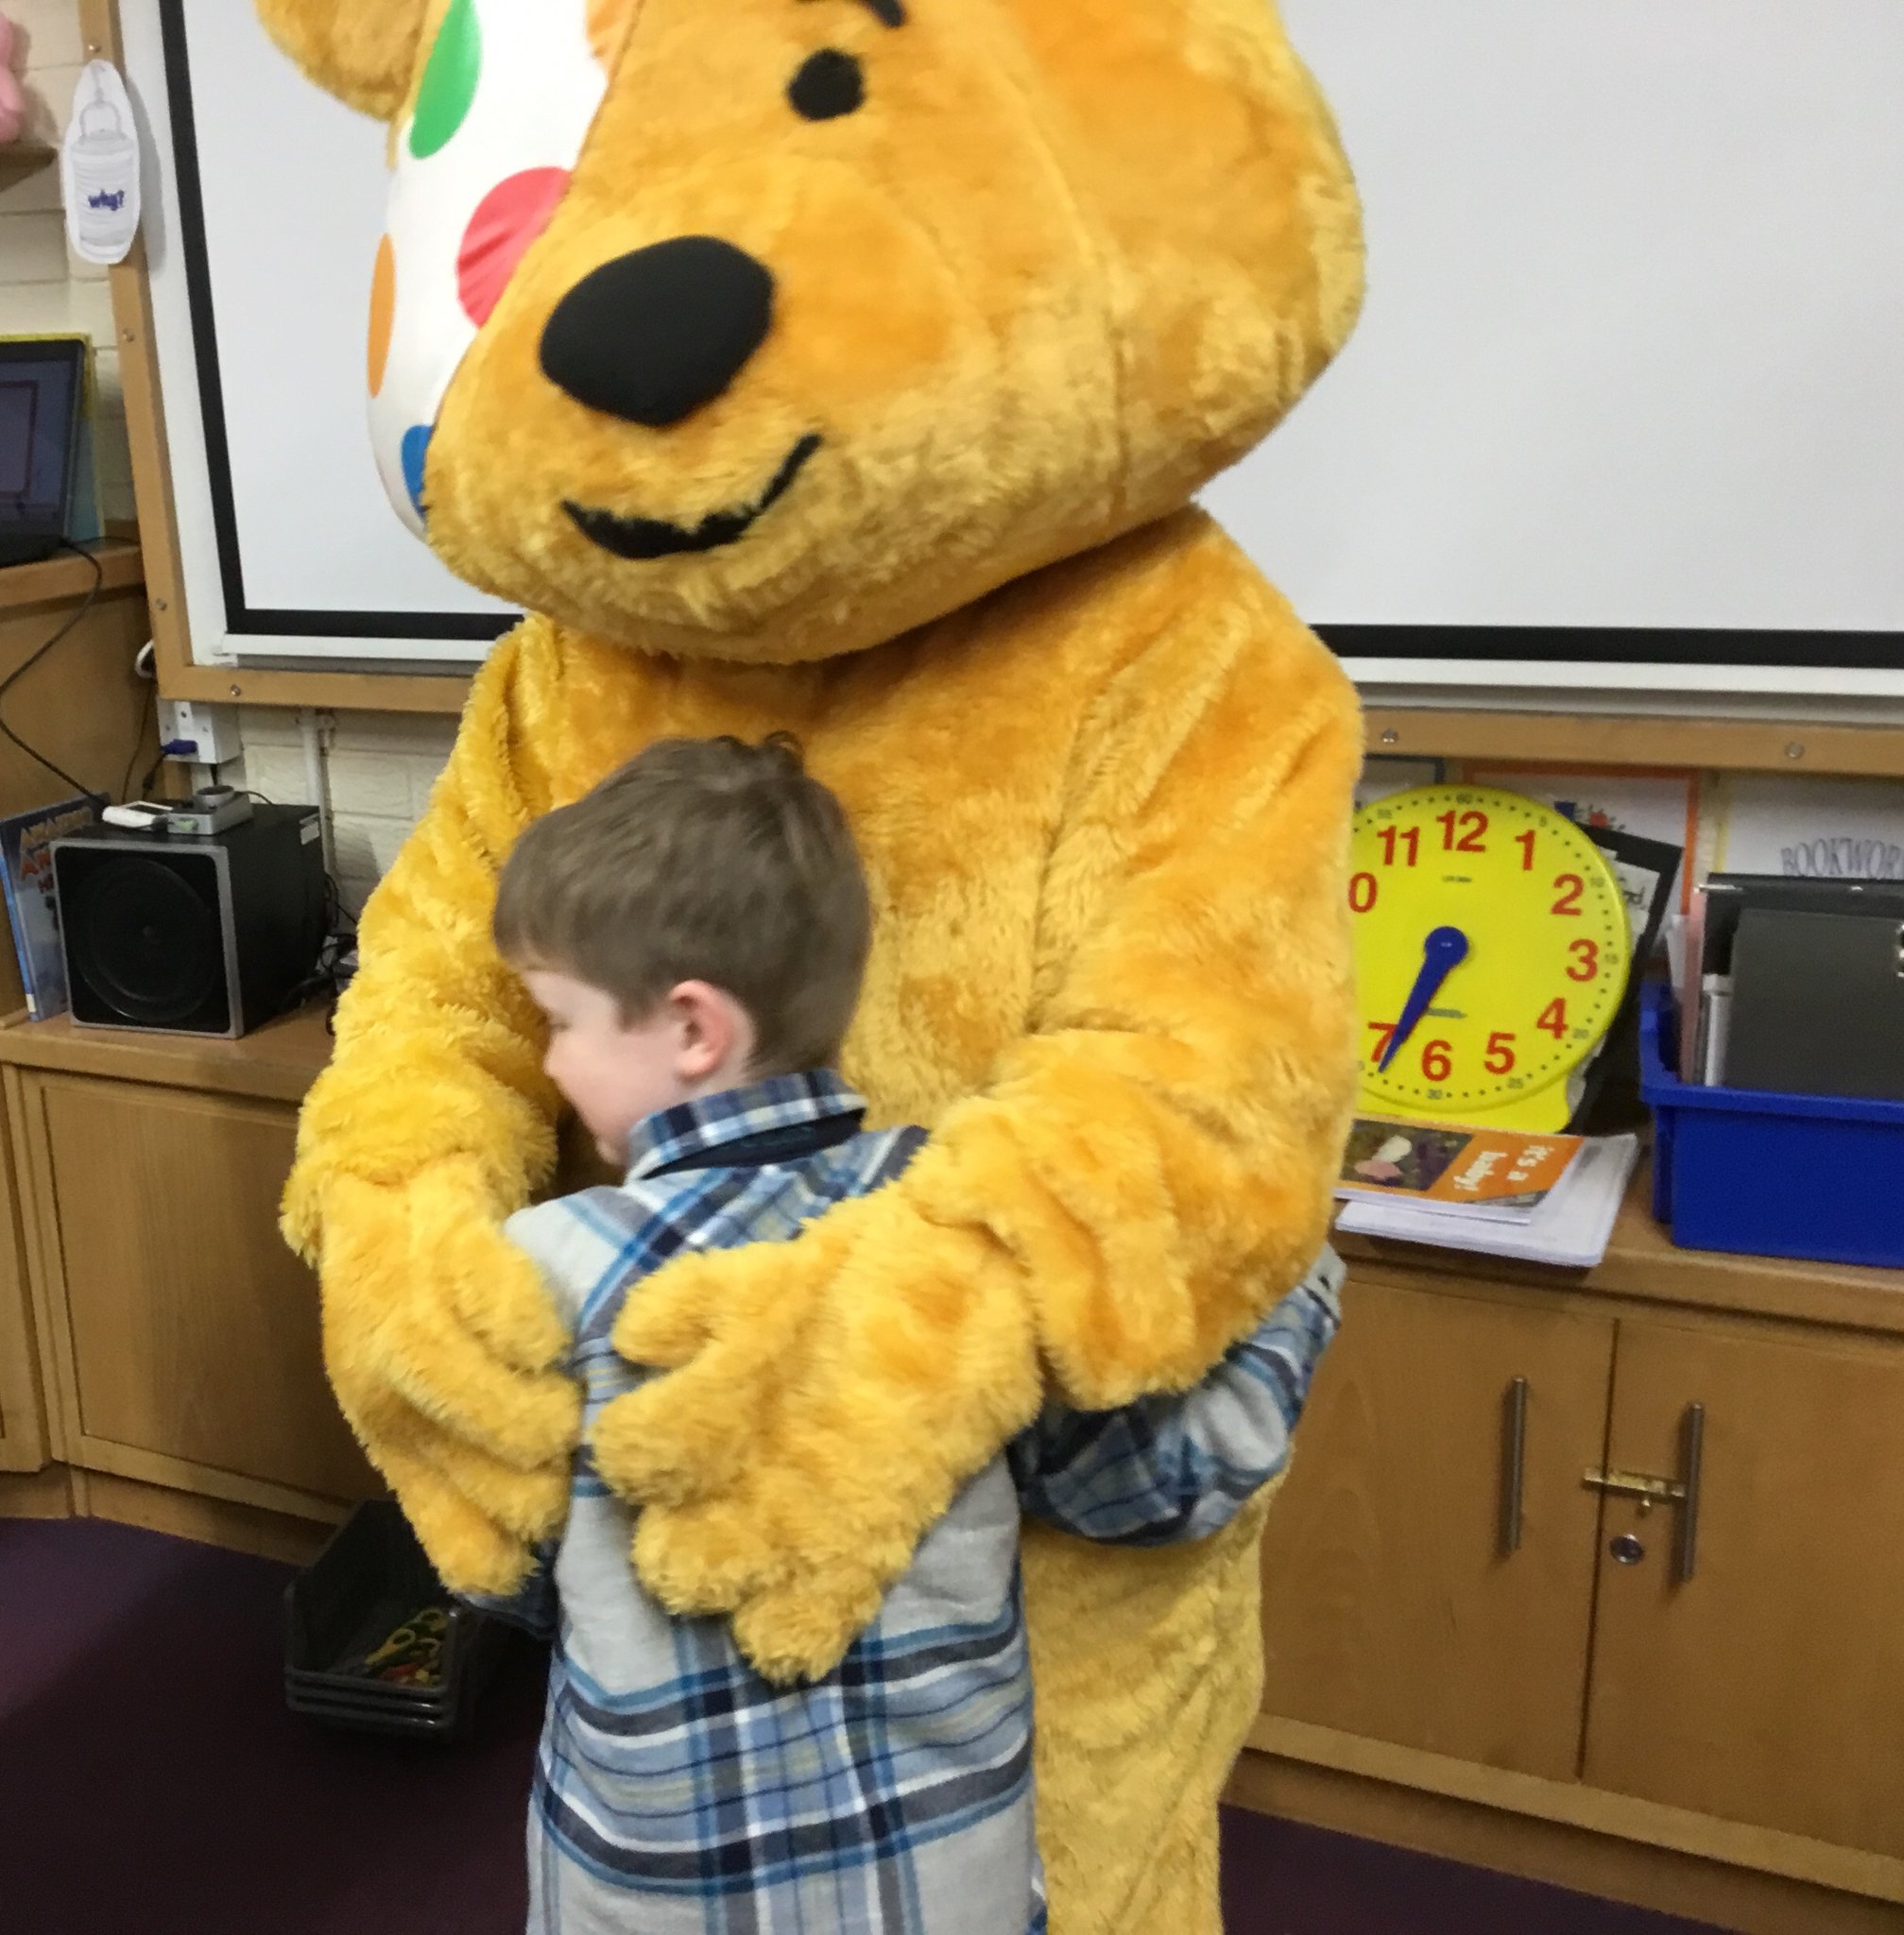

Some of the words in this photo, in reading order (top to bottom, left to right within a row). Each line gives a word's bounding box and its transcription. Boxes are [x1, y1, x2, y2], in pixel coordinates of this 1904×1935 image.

[1377, 825, 1420, 867] 11
[1436, 810, 1488, 852] 12
[1515, 830, 1535, 870] 1
[1348, 872, 1378, 913] 0
[1551, 874, 1585, 916] 2
[1566, 938, 1599, 982] 3
[1535, 997, 1569, 1039] 4
[1367, 1021, 1398, 1063] 7
[1421, 1039, 1452, 1082] 6
[1484, 1031, 1516, 1075] 5
